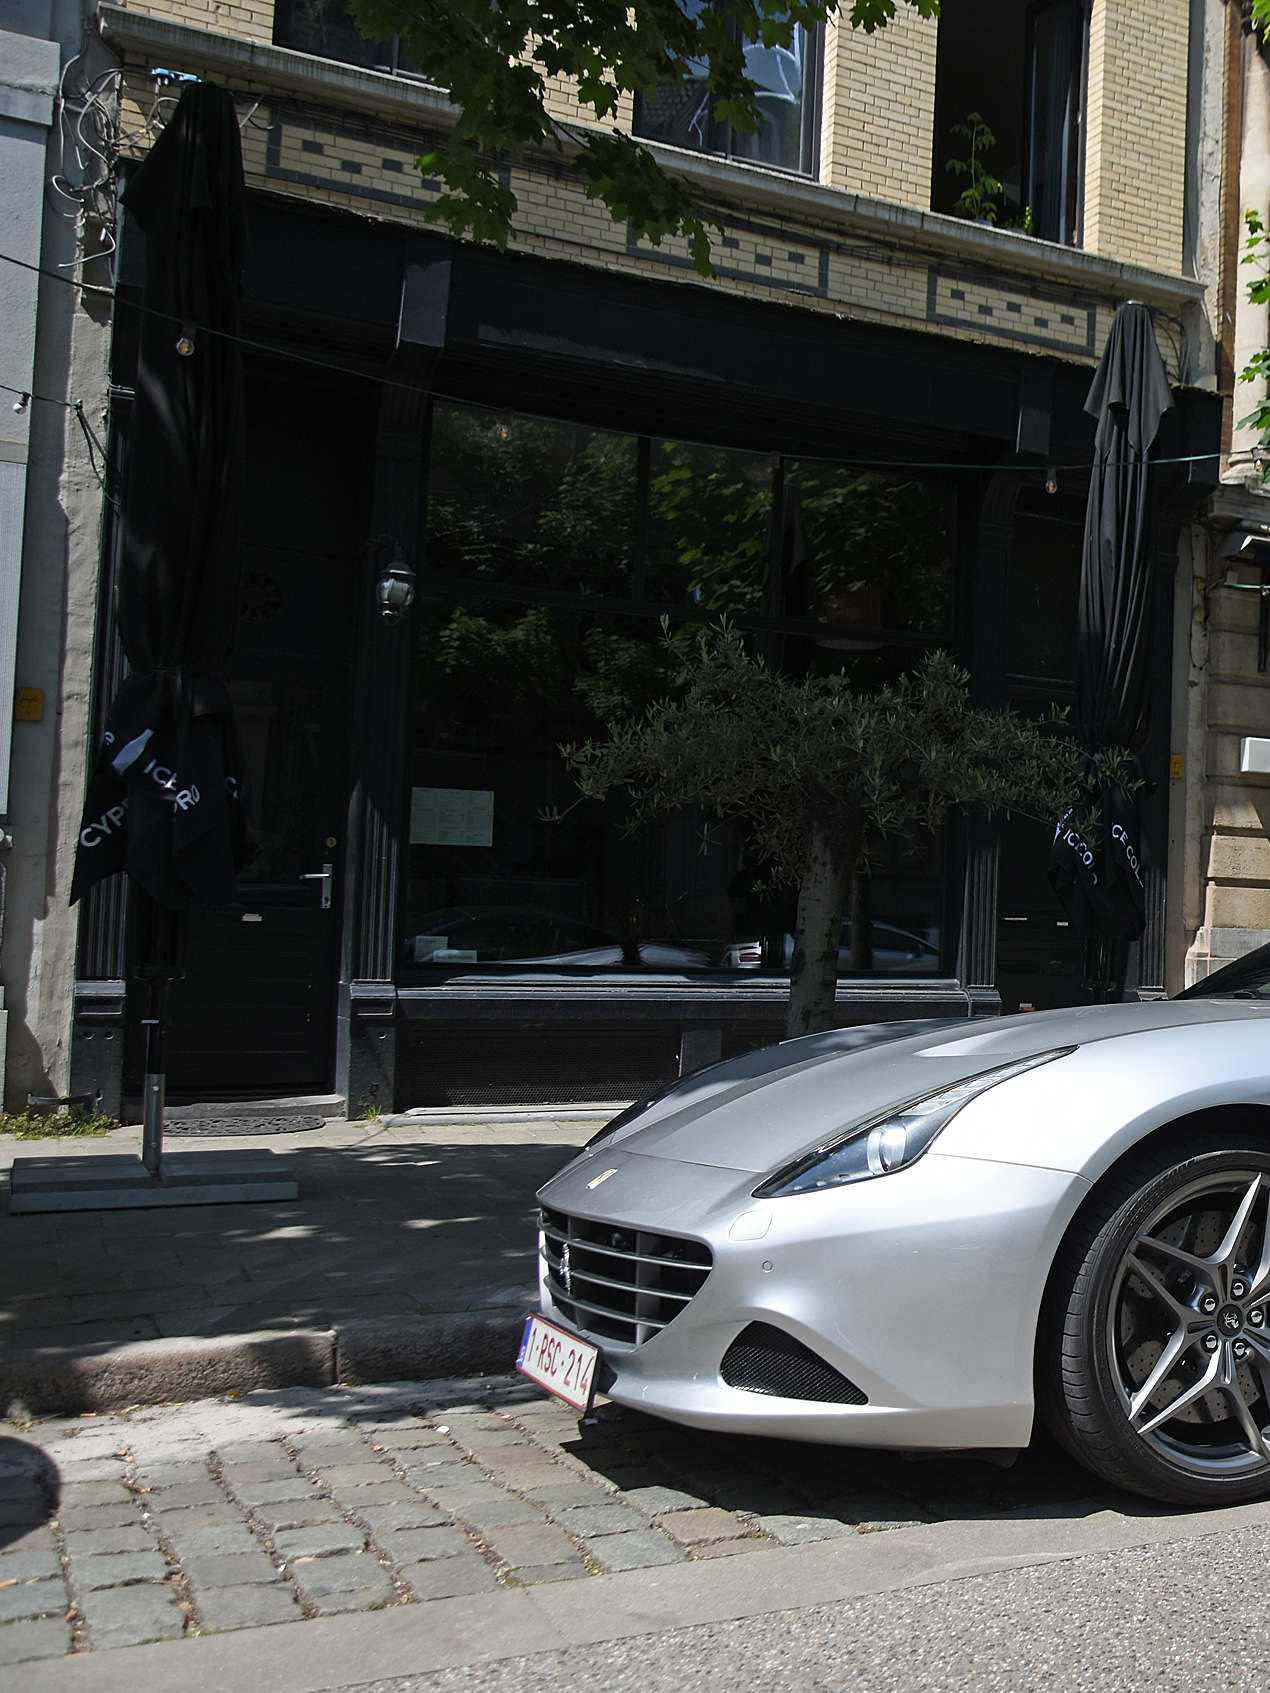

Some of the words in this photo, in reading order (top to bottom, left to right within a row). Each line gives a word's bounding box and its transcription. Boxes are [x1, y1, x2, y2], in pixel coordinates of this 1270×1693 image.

[80, 797, 128, 847] CYP
[1111, 822, 1129, 846] CE
[1126, 845, 1144, 888] COL
